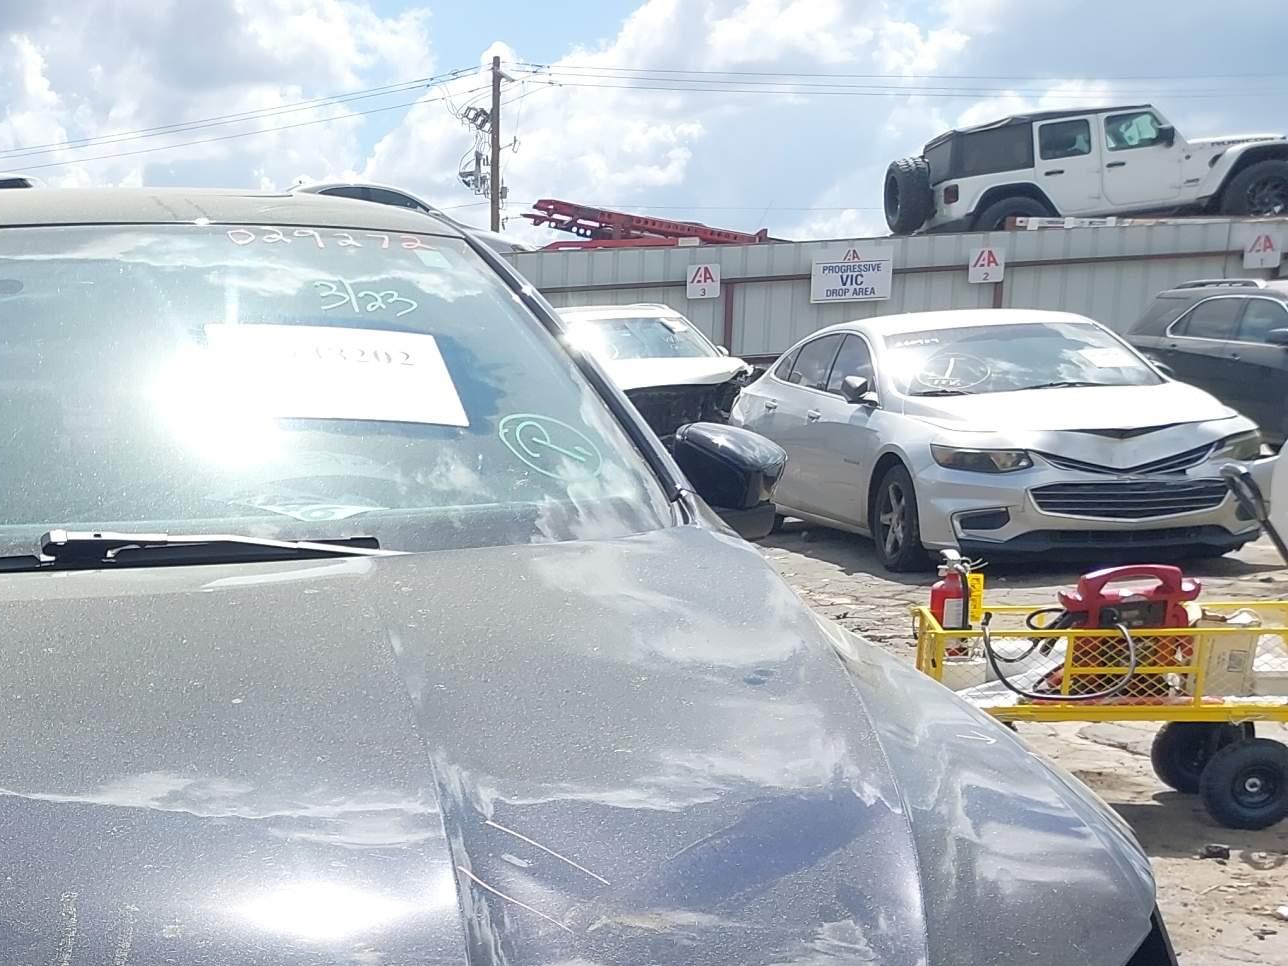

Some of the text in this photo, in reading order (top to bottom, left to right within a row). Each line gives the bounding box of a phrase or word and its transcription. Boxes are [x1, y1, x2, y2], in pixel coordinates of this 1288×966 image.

[822, 263, 882, 274] PROGRESSIVE
[840, 274, 864, 287] VIC
[982, 271, 990, 281] 2
[699, 287, 707, 297] 3
[825, 287, 876, 298] DROP AREA
